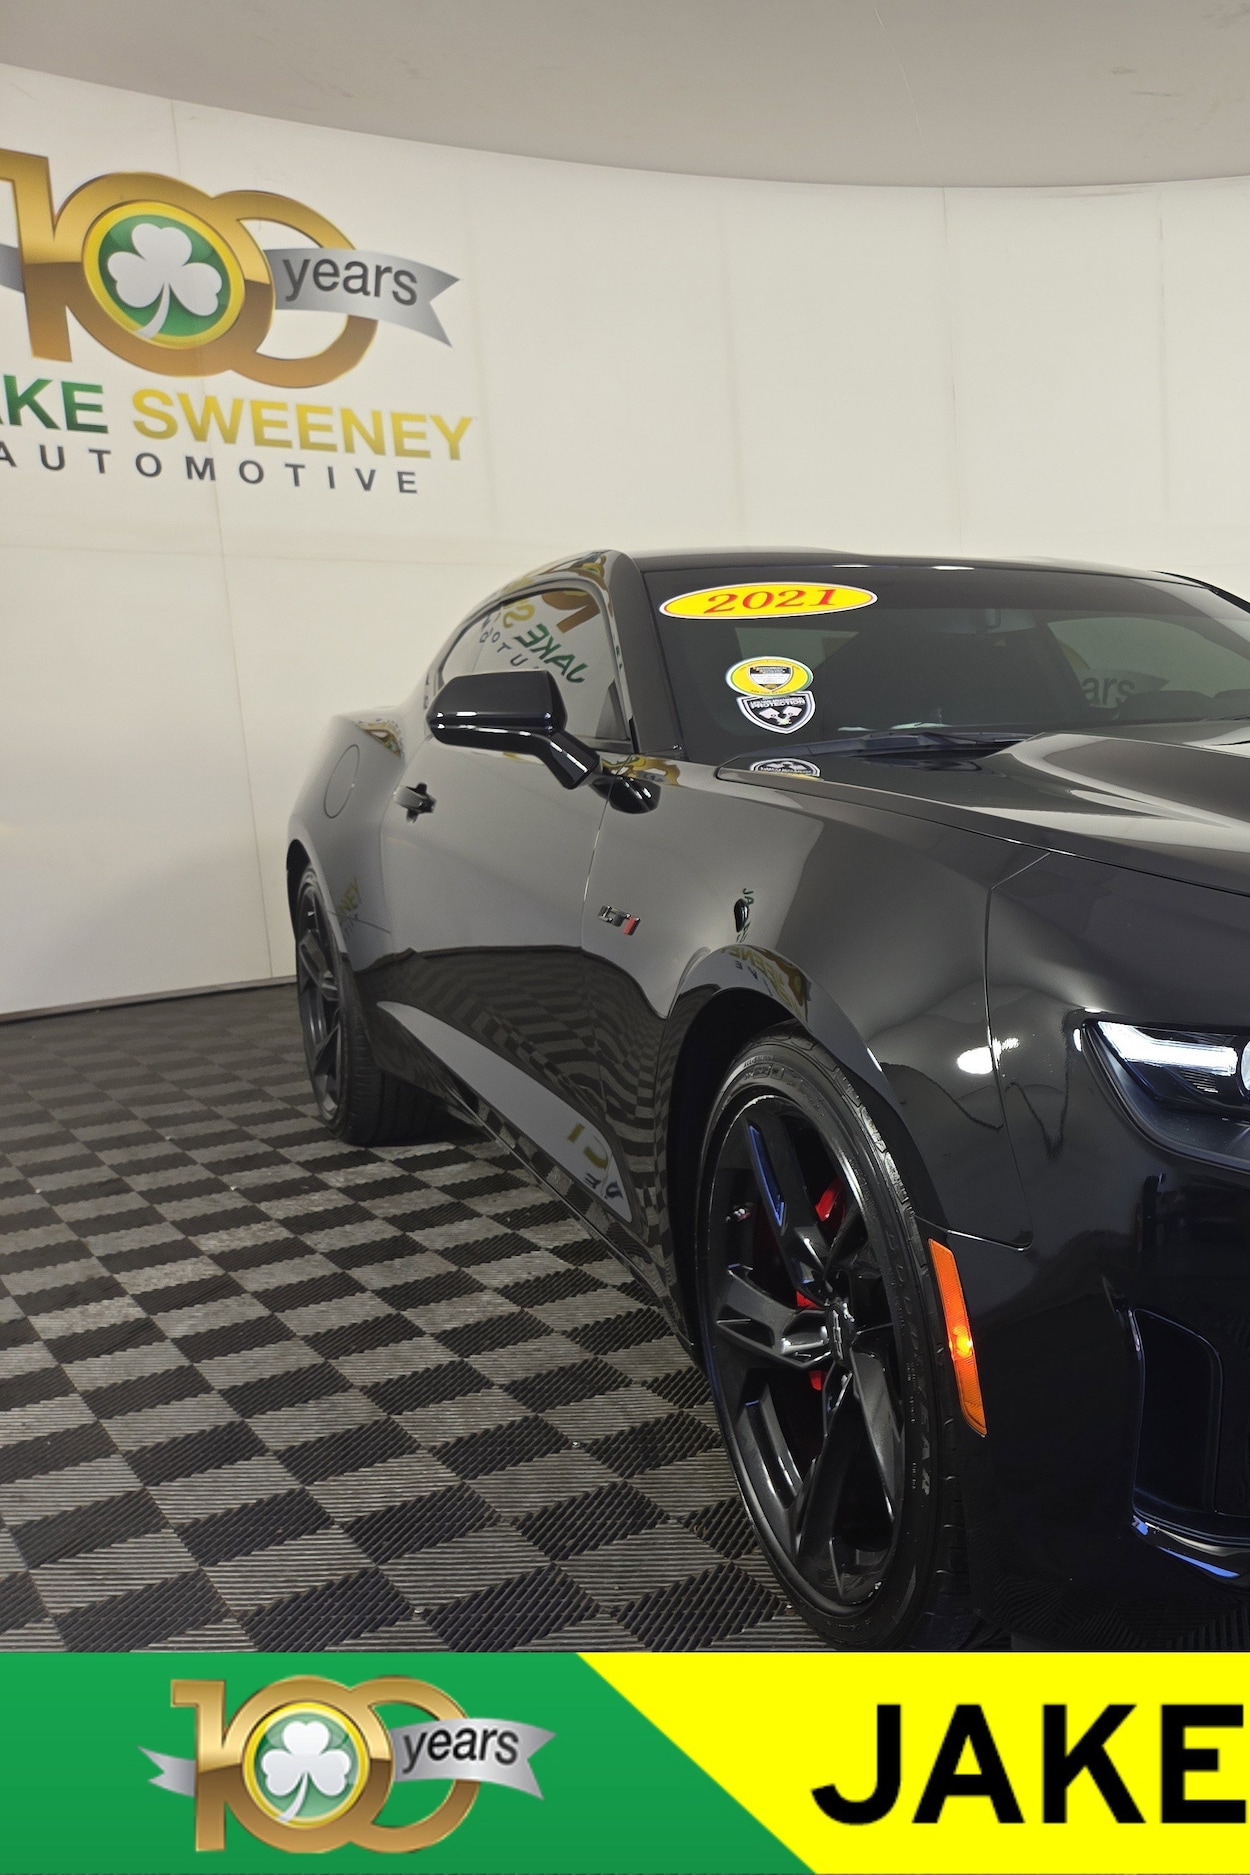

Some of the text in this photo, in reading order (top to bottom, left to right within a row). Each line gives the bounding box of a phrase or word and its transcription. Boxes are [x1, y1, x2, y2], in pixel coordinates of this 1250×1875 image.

[282, 256, 418, 306] years
[0, 374, 473, 461] KE SWEENEY
[0, 440, 418, 494] AUTOMOTIVE
[704, 589, 836, 613] 2021
